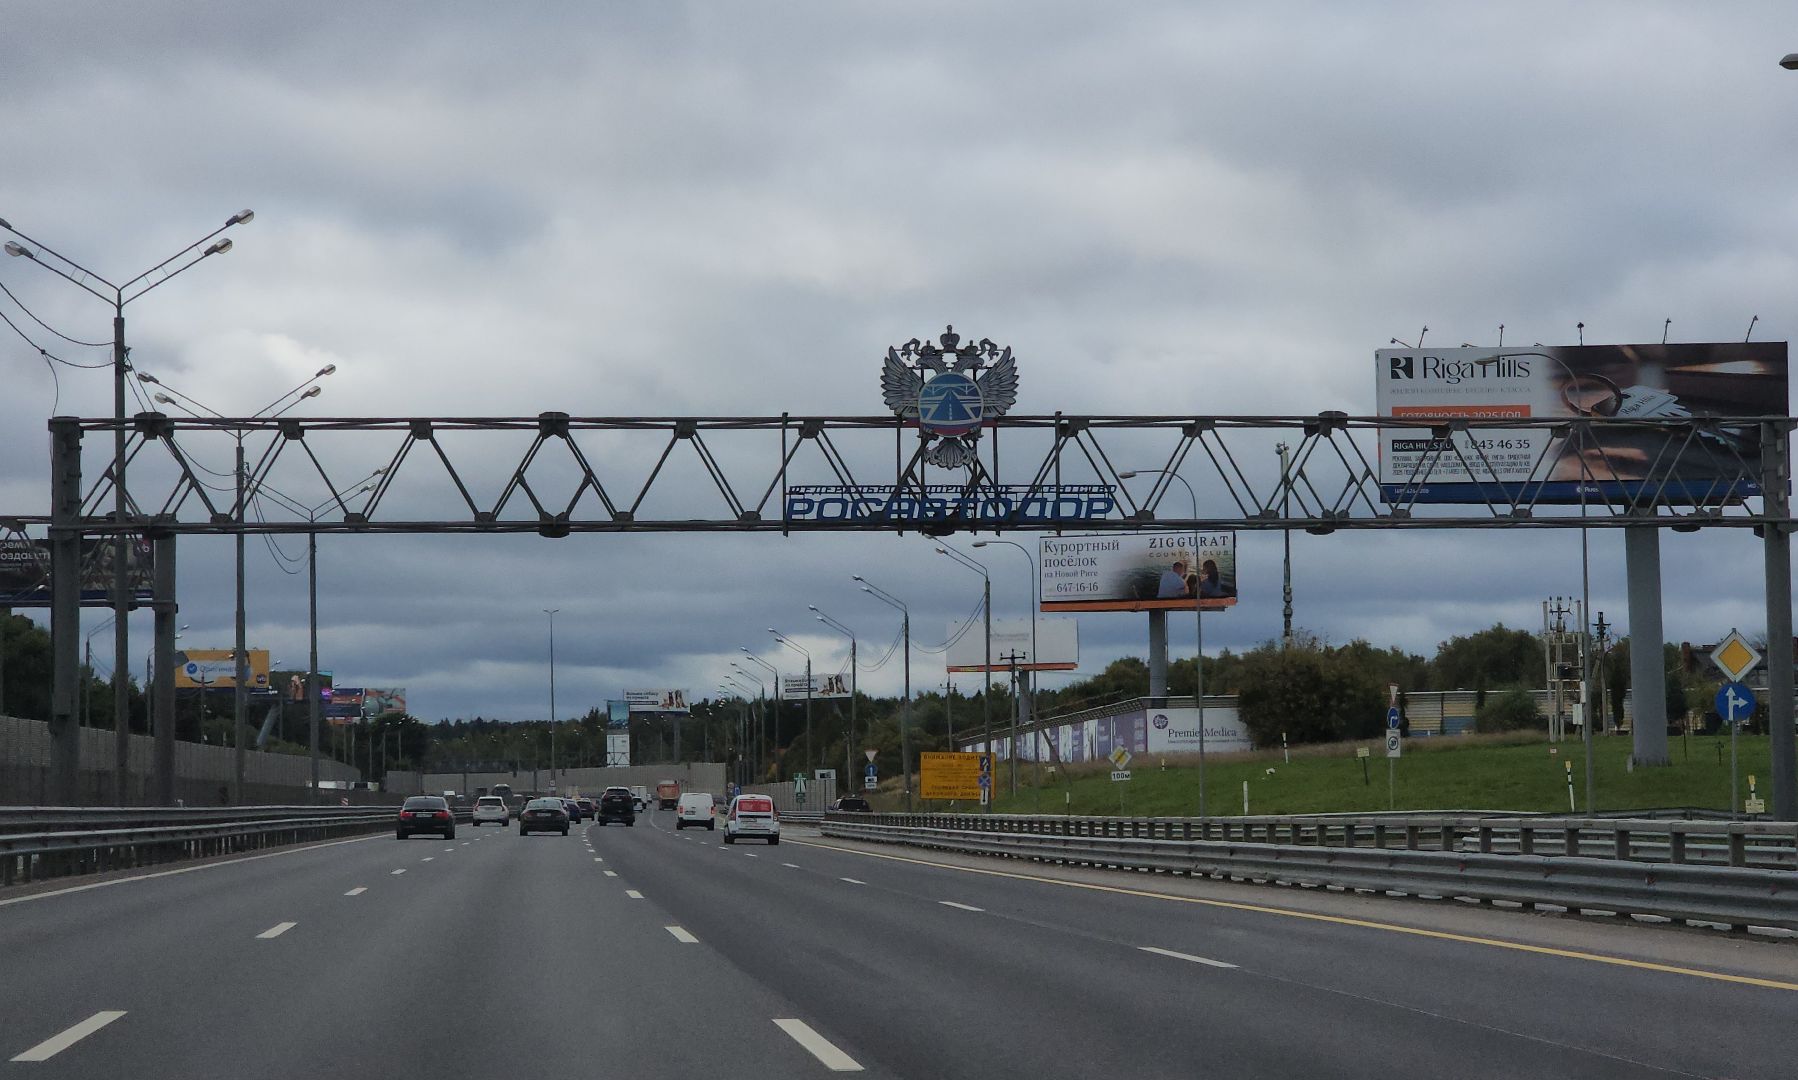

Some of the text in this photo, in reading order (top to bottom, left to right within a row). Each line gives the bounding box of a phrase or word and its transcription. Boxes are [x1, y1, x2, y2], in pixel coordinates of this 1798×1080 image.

[1423, 356, 1474, 384] Riga
[1497, 439, 1513, 449] 46
[1515, 439, 1531, 449] 35
[1044, 540, 1120, 555] Курортный
[1149, 536, 1229, 549] ZIGGURAT
[1044, 556, 1098, 567] посёлок
[1056, 582, 1099, 592] 647-16-16
[1168, 727, 1237, 738] Premie Medica
